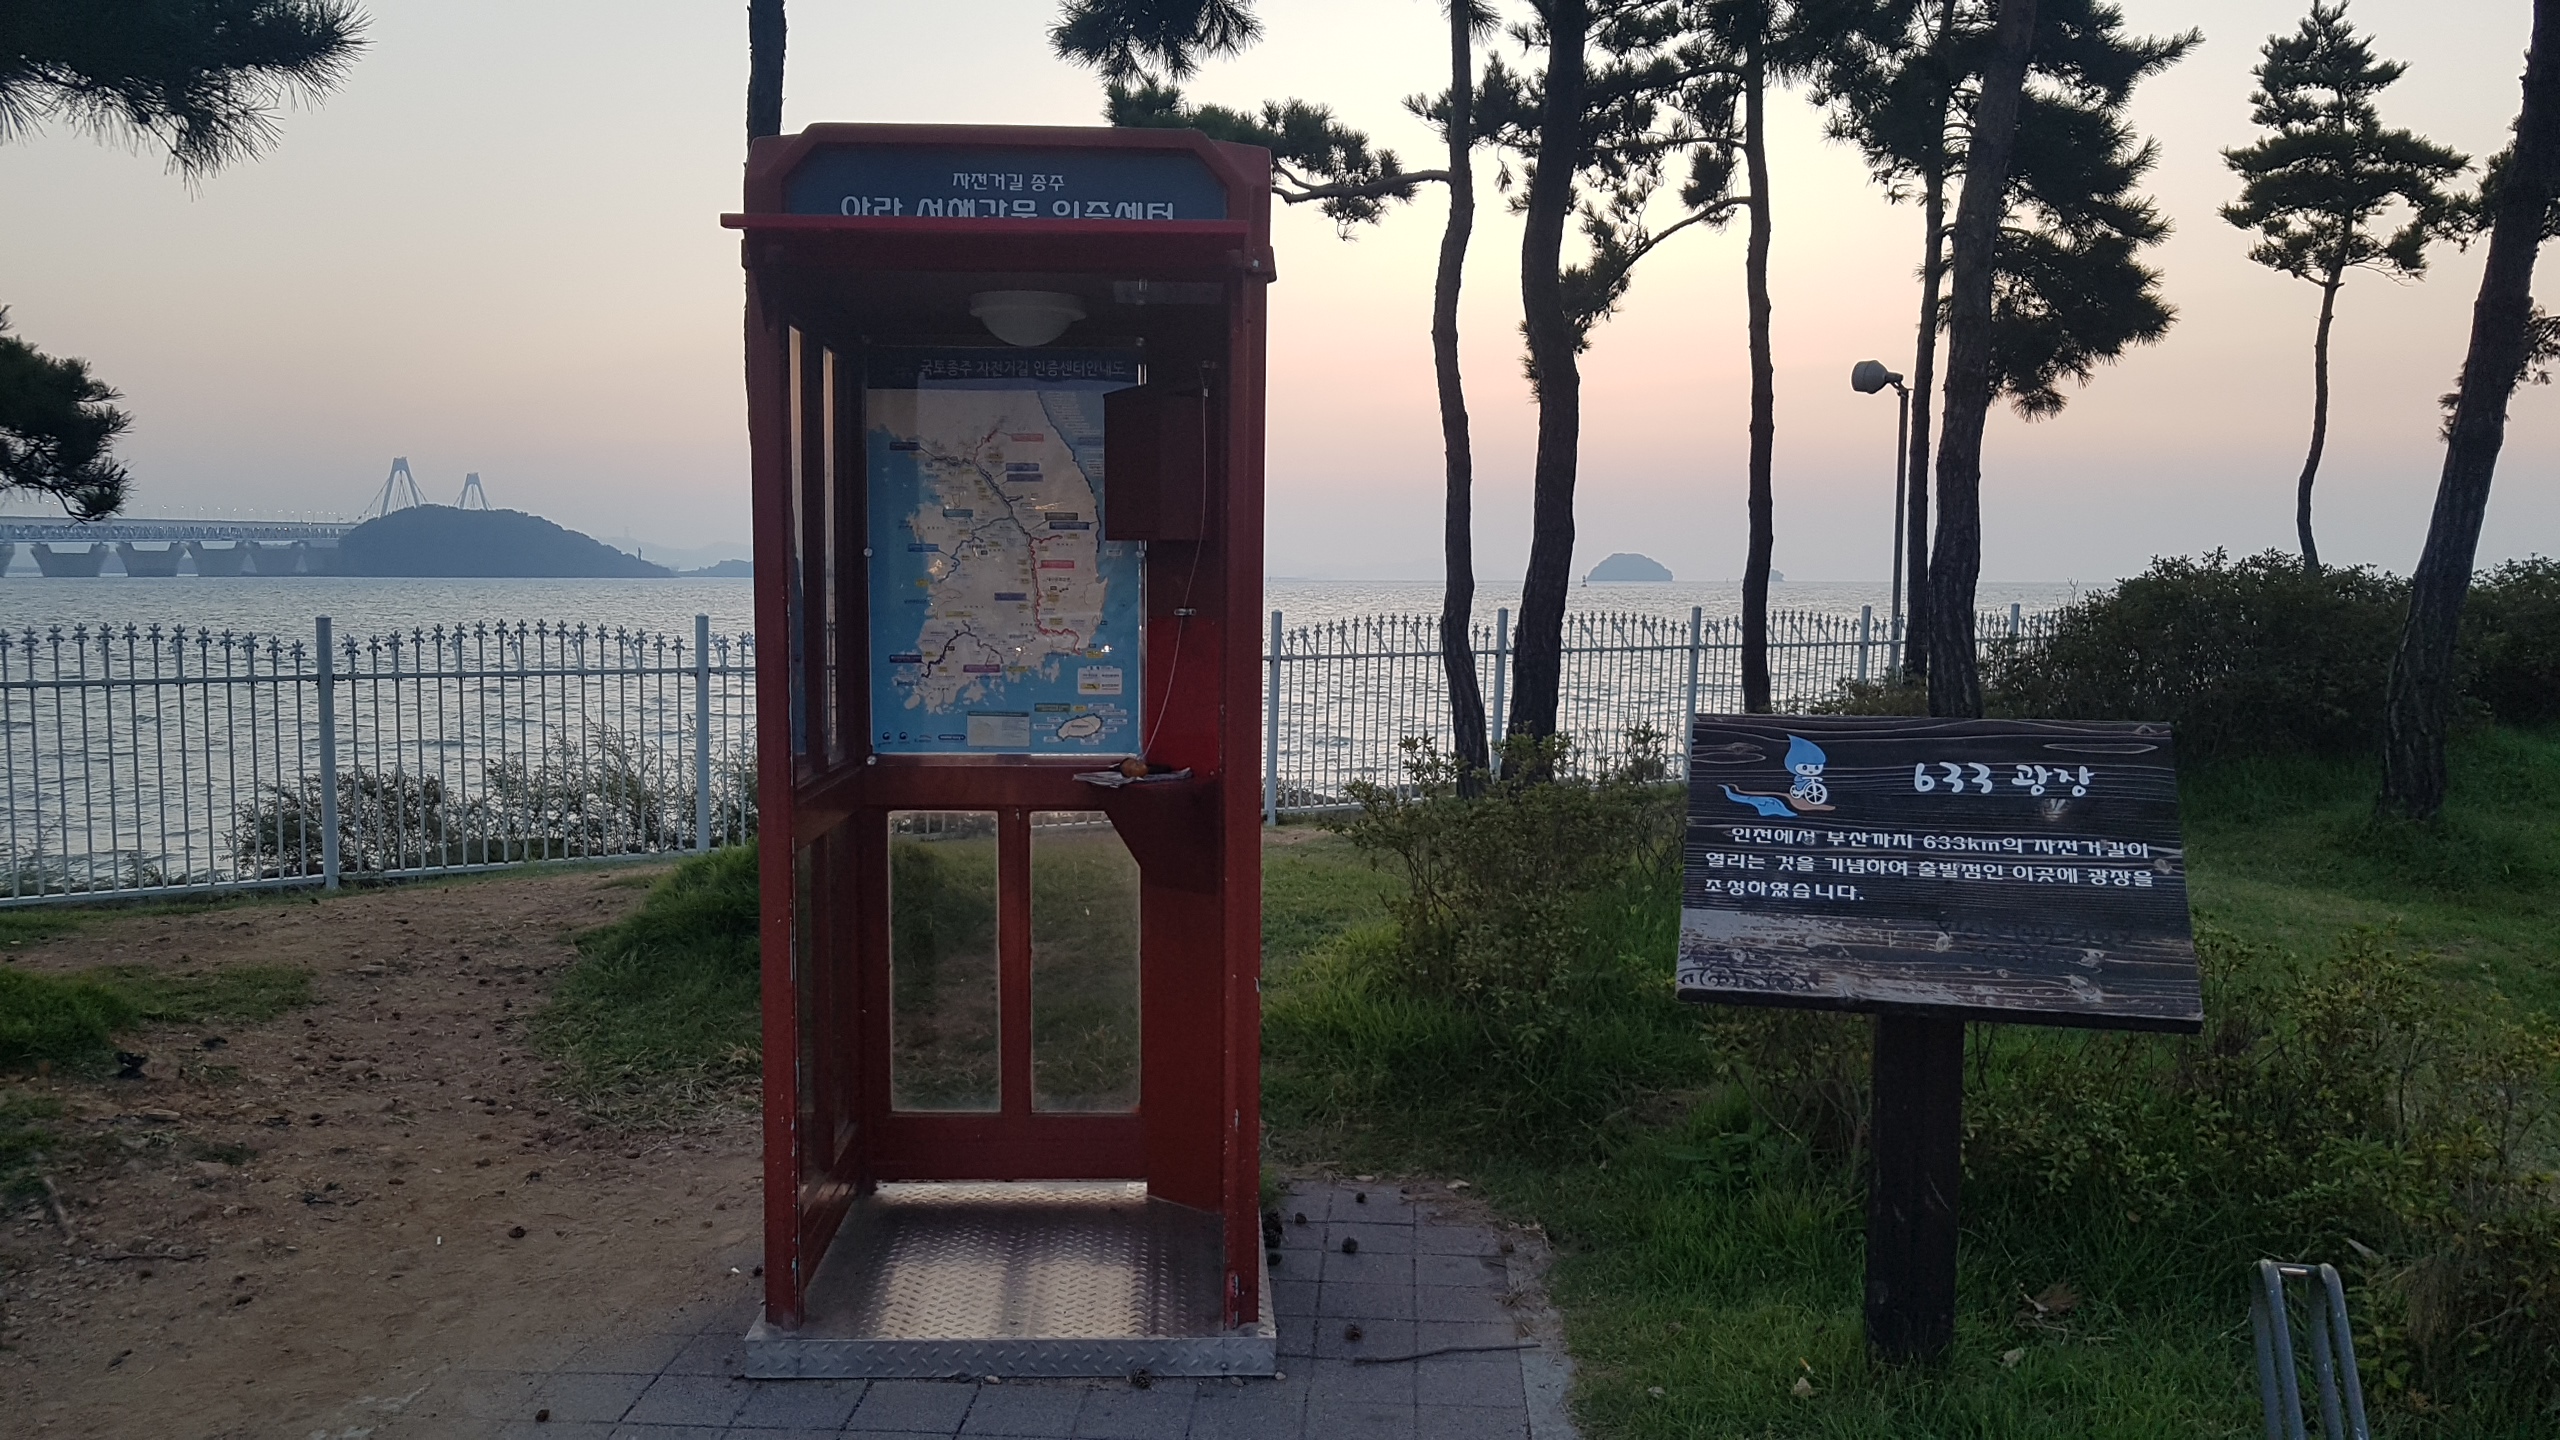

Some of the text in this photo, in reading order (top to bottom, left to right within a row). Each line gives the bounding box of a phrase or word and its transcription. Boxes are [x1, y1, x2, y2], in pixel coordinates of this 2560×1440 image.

[952, 172, 1065, 192] 자전거길 종주
[920, 359, 973, 377] 국토종주
[976, 359, 1029, 377] 자전거길
[1914, 761, 2095, 797] 633 광장
[1731, 827, 2149, 859] 인천에서 부산까지 633km의 자전거길이
[1705, 852, 2153, 888] 열리는 것을 기념하여 출발점인 이곳에 광장을
[1704, 878, 1866, 901] 조성하였습니다.
